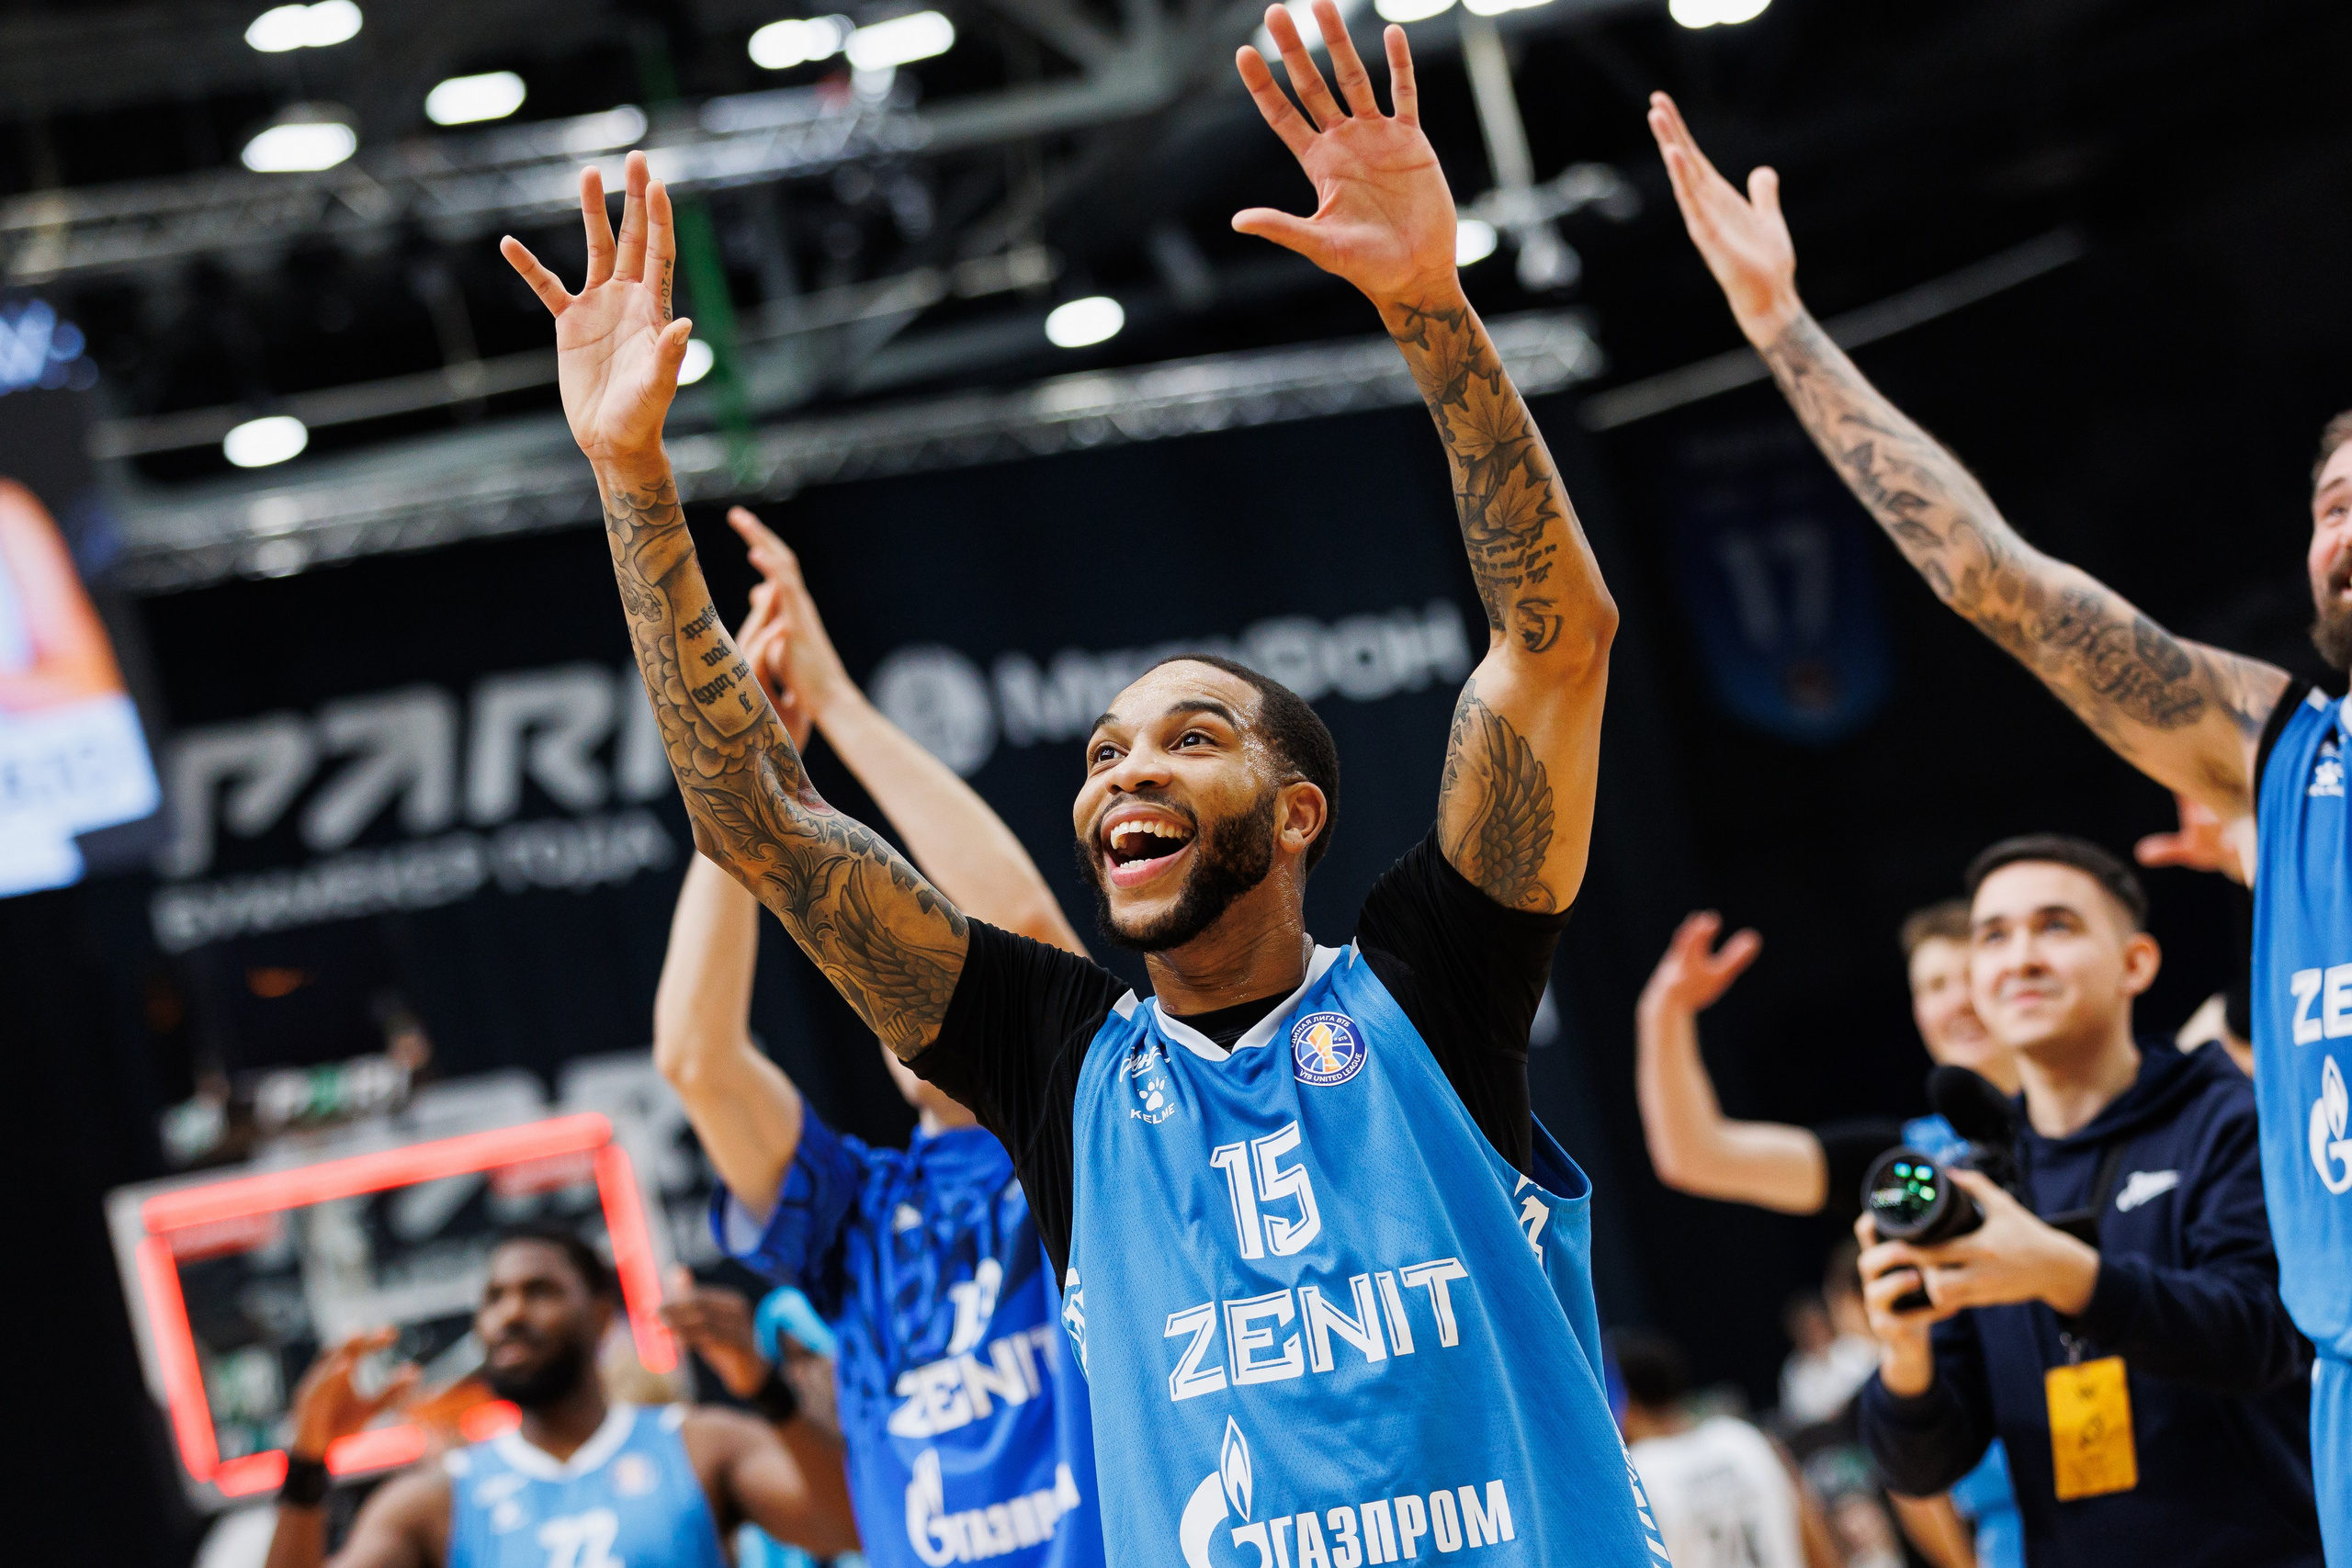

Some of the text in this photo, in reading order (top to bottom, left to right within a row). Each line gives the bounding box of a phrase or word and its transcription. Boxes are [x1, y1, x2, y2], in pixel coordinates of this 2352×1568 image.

[1313, 1015, 1335, 1023] ЛИГА
[1336, 1016, 1351, 1028] ВТБ
[1299, 1052, 1363, 1082] VTB UNITED LEAGUE
[1130, 1102, 1175, 1124] KELME
[1208, 1119, 1321, 1259] 15
[1163, 1257, 1469, 1402] ZENIT
[1270, 1479, 1516, 1568] ГАЗПРОМ
